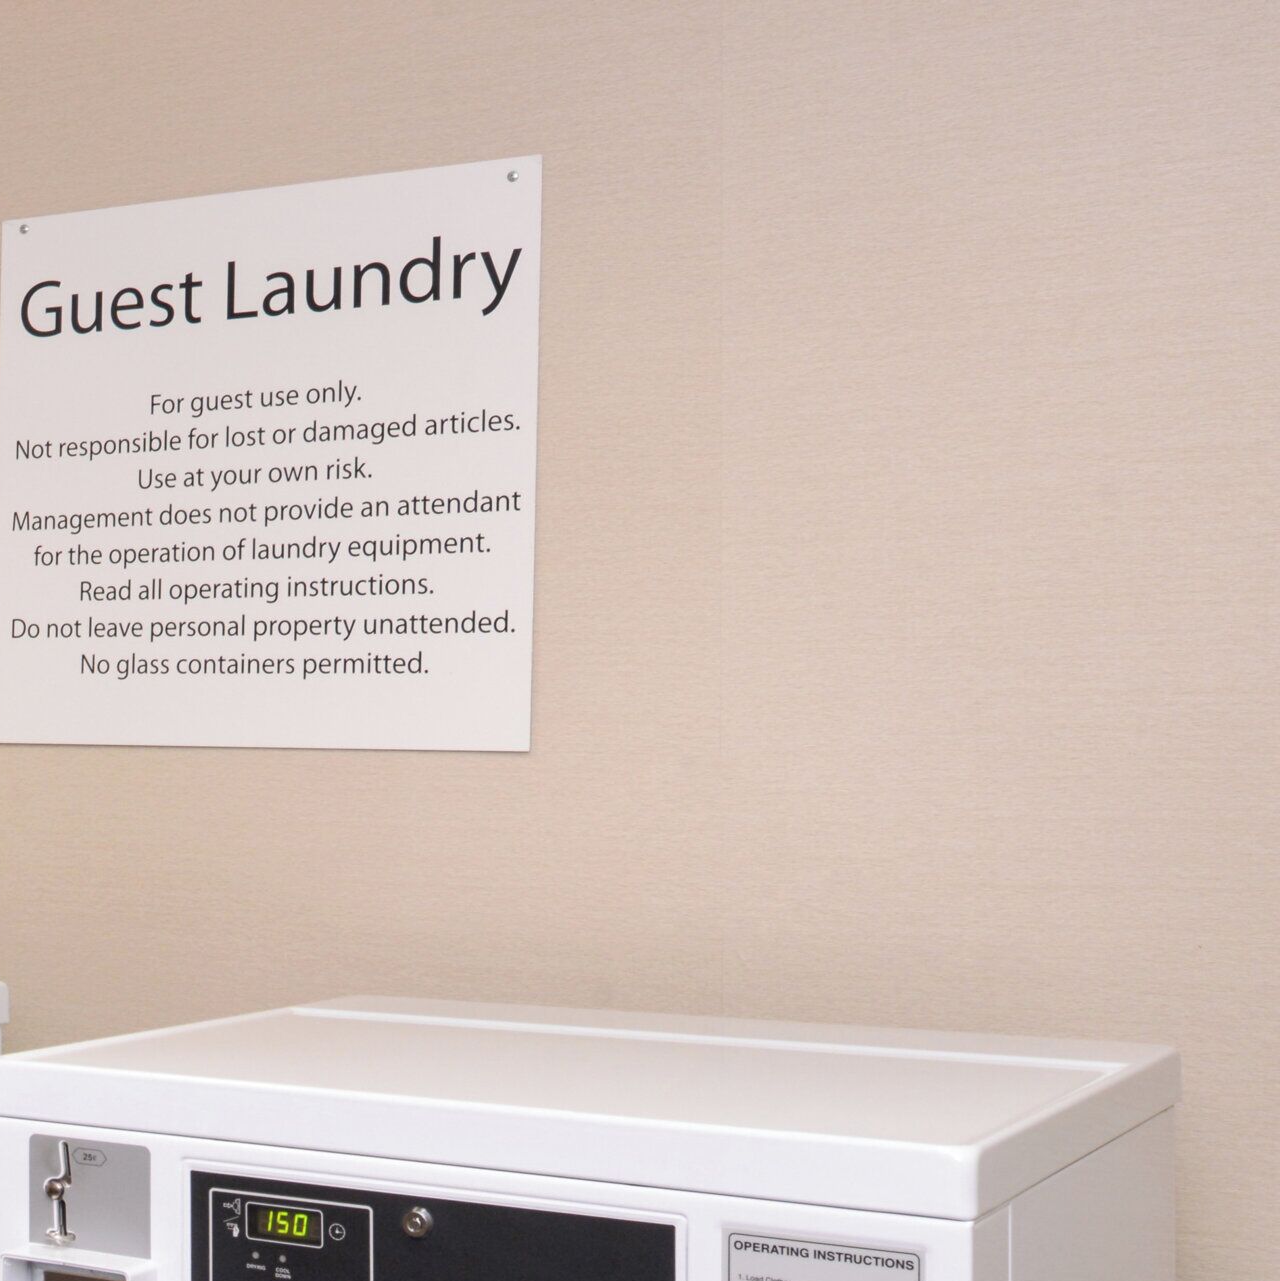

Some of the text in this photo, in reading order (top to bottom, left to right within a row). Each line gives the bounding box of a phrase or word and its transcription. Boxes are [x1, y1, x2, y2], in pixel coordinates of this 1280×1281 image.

[20, 235, 523, 338] Guest Laundry
[150, 379, 362, 419] For guest use only.
[15, 408, 521, 462] Not responsible for lost or damaged articles.
[138, 456, 373, 493] Use at your own risk.
[12, 489, 522, 535] Management does not provide an attendant
[33, 533, 491, 570] for the operation of laundry equipment.
[79, 573, 434, 606] Read all operating instructions.
[11, 609, 516, 643] Do not leave personal property unattended.
[80, 650, 429, 681] No glass containers permitted.
[267, 1211, 308, 1236] 150
[734, 1240, 915, 1270] OPERATING INSTRUCTIONS
